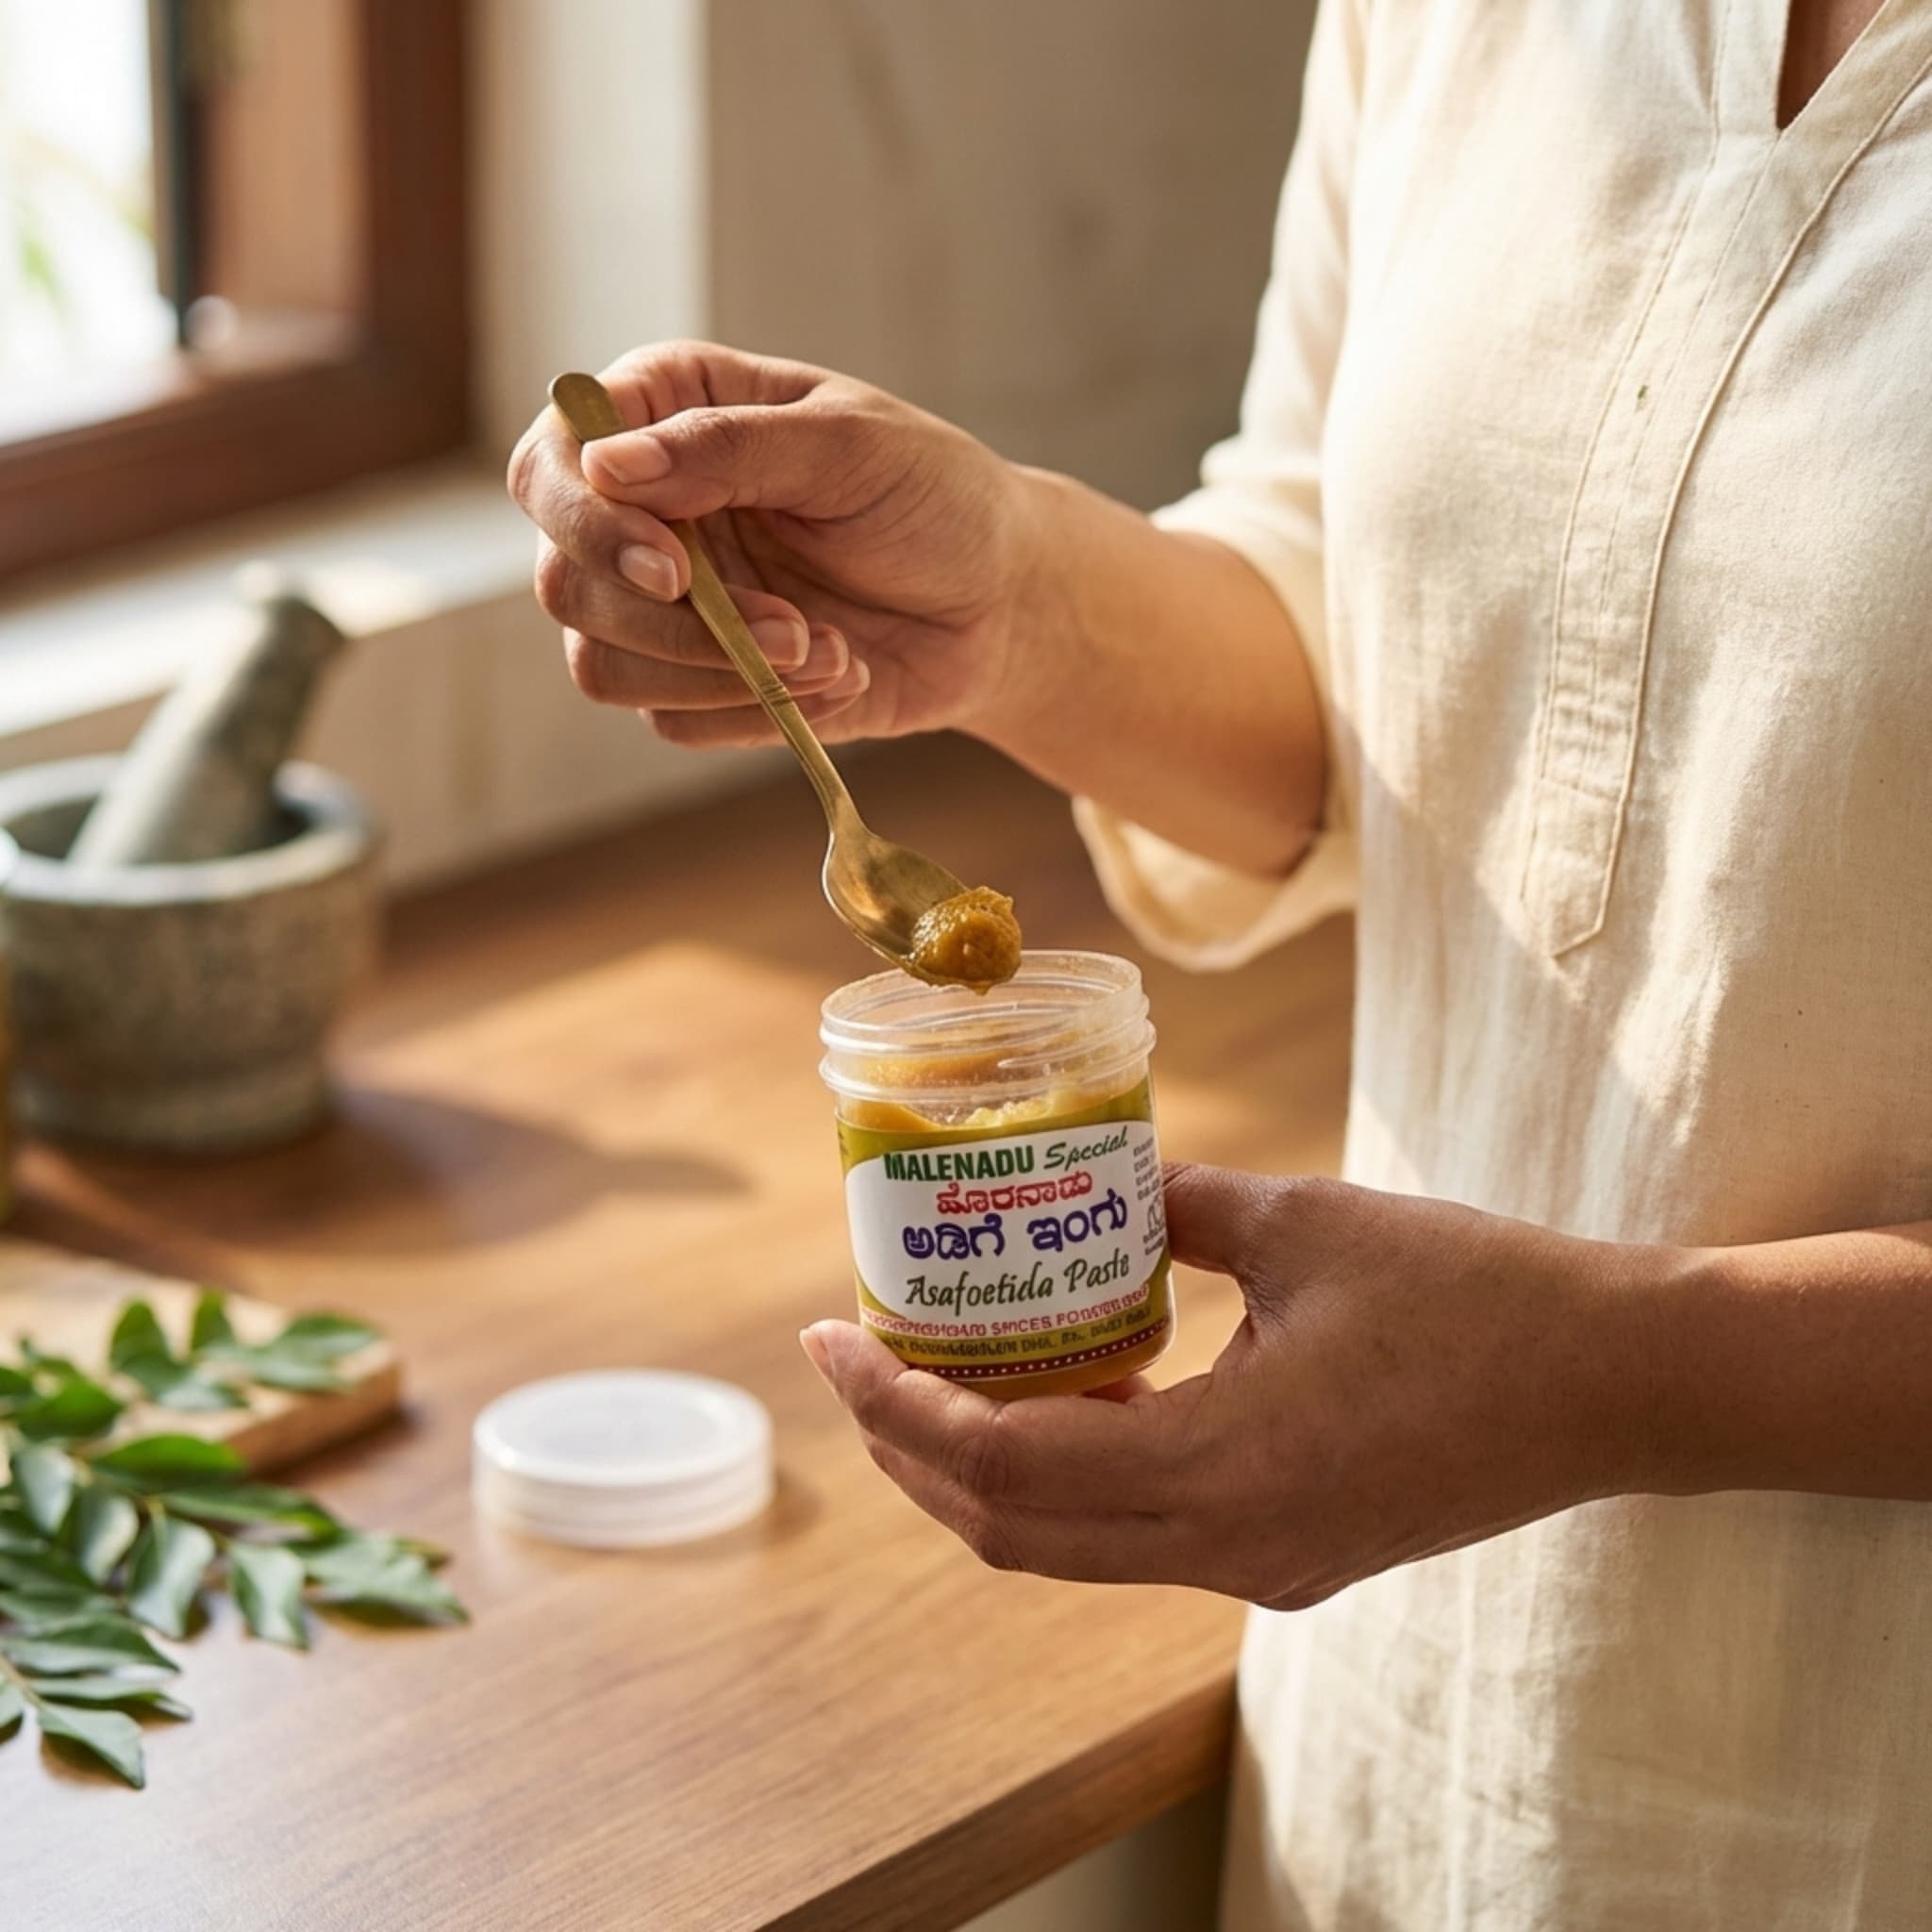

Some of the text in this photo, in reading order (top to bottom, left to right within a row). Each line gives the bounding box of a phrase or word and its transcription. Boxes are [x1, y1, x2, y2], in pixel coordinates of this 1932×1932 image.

[883, 1145, 1035, 1182] MALENADU
[1042, 1125, 1128, 1172] Special
[902, 1212, 1006, 1261] ಅಡಿಗೆ
[1026, 1187, 1128, 1253] ಇಂಗು
[905, 1260, 1054, 1317] Asafoetida
[1063, 1247, 1130, 1293] Paste
